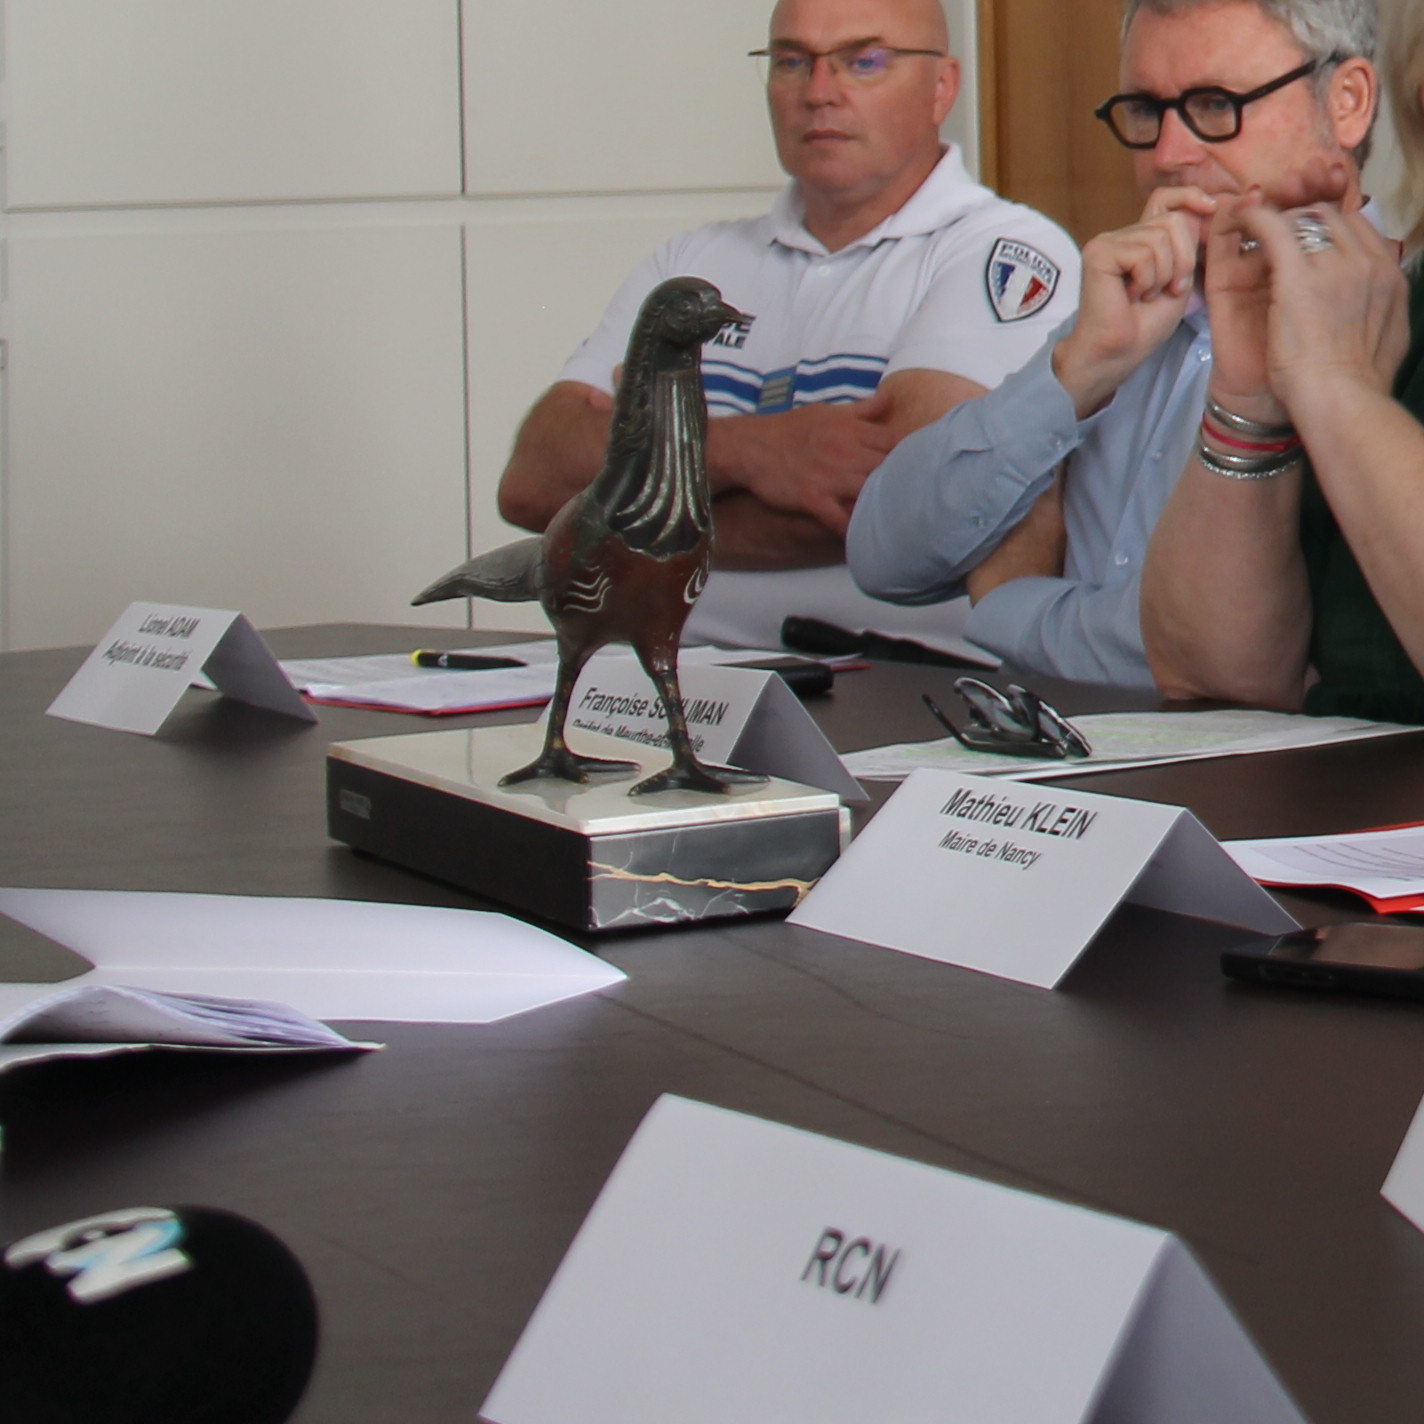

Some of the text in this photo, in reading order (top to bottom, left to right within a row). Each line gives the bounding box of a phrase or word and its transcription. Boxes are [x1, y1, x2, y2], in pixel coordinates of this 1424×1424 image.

[579, 687, 649, 718] Françoise
[939, 787, 1098, 840] Mathieu KLEIN
[937, 829, 1042, 871] Maire de Nancy
[801, 1226, 902, 1304] RCN
